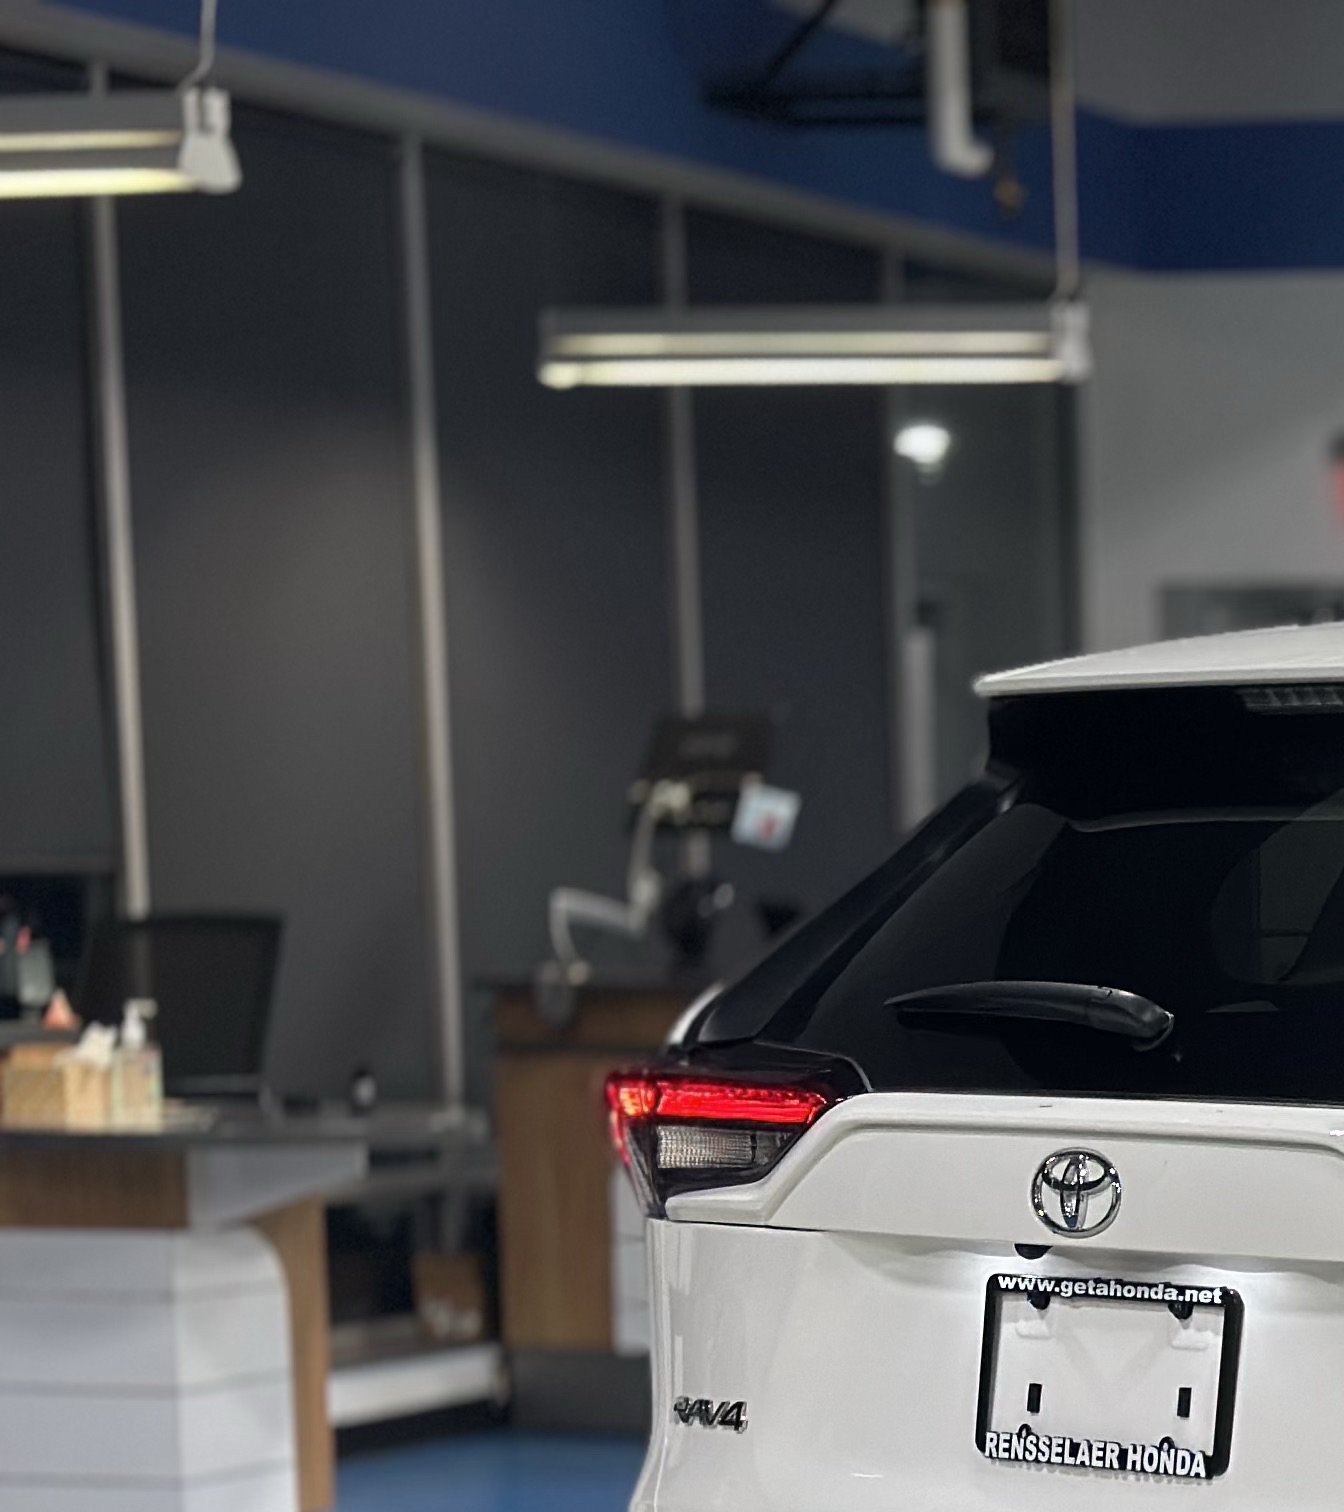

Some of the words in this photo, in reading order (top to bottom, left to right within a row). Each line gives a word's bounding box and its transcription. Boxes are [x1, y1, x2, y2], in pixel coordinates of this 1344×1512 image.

[997, 1274, 1223, 1304] www.getahonda.net
[673, 1396, 748, 1433] RAV4
[984, 1431, 1120, 1469] RENSSELAER
[1126, 1443, 1207, 1478] HONDA
